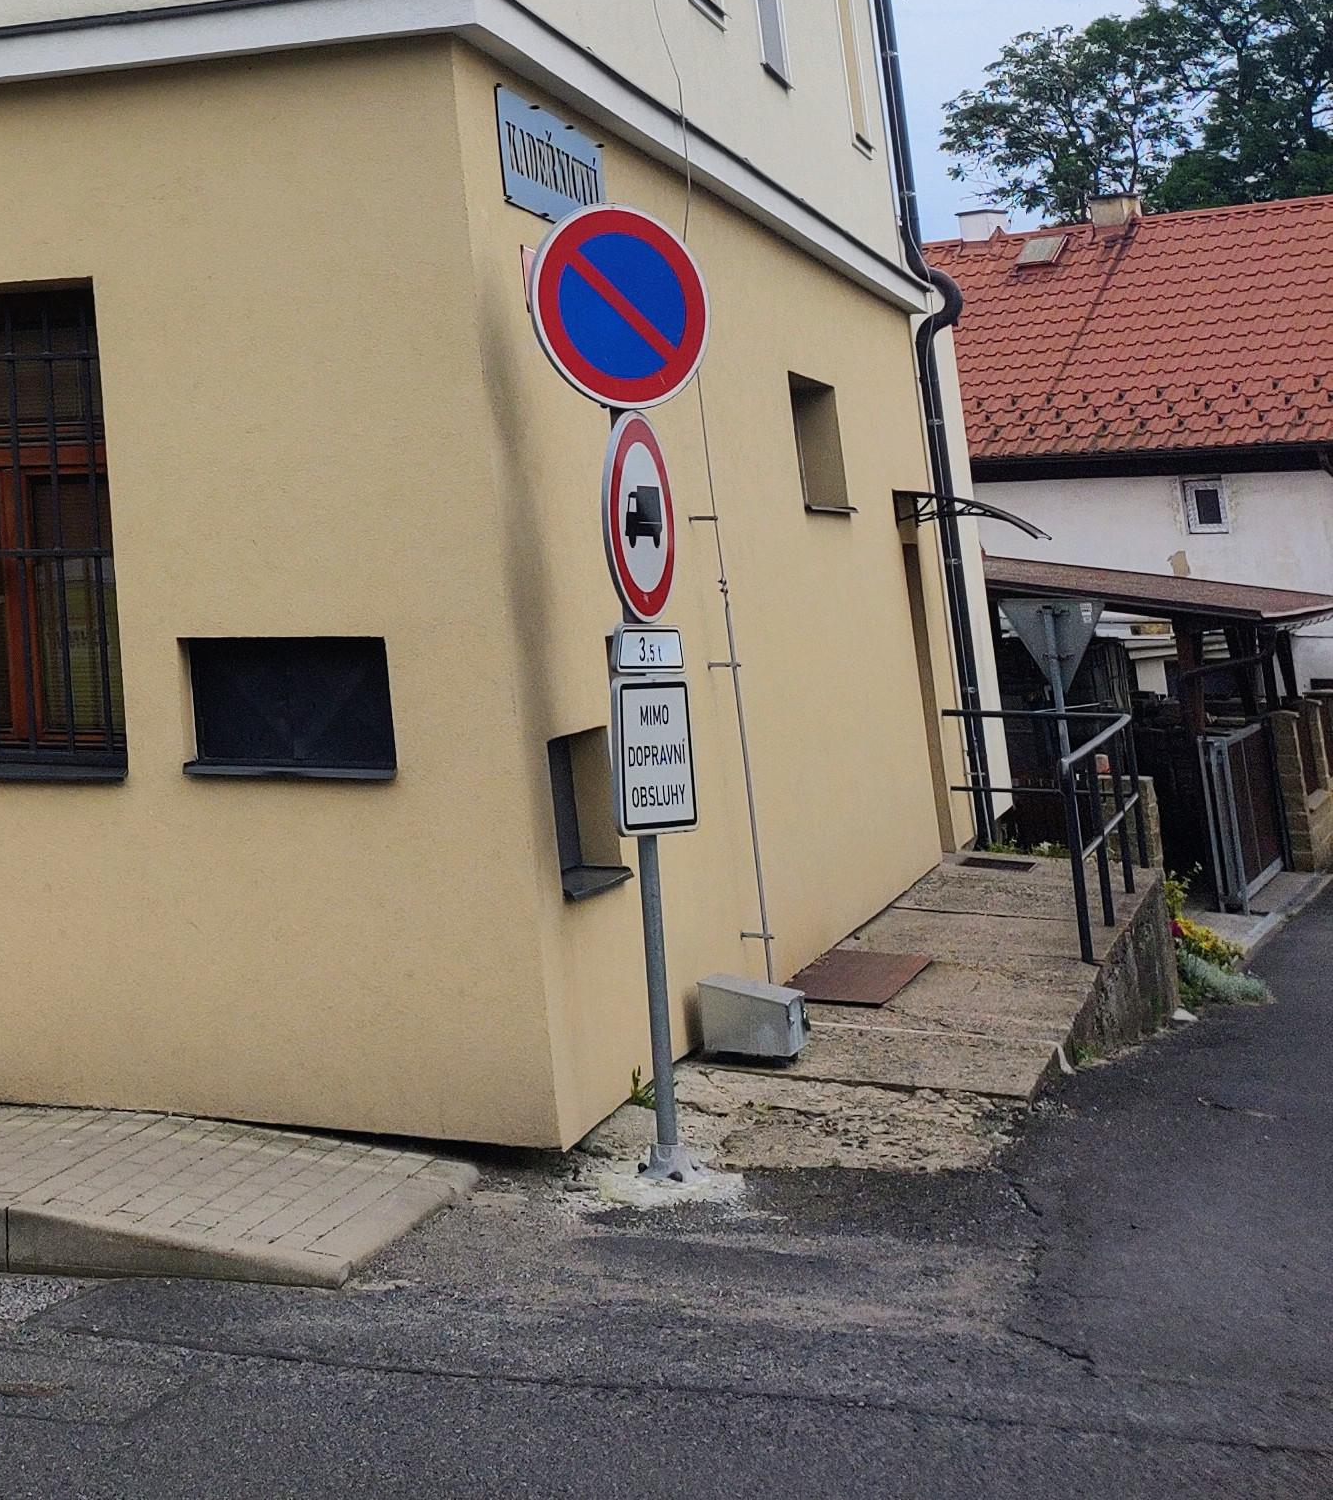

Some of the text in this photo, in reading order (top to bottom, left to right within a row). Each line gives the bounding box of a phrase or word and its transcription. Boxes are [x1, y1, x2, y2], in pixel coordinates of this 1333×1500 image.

[504, 120, 600, 206] KADEŘNICTVÍ
[639, 636, 663, 663] 3,5 t
[639, 704, 670, 727] MIMO
[628, 738, 686, 768] DOPRAVNÍ
[631, 784, 686, 808] OBSLUHY
